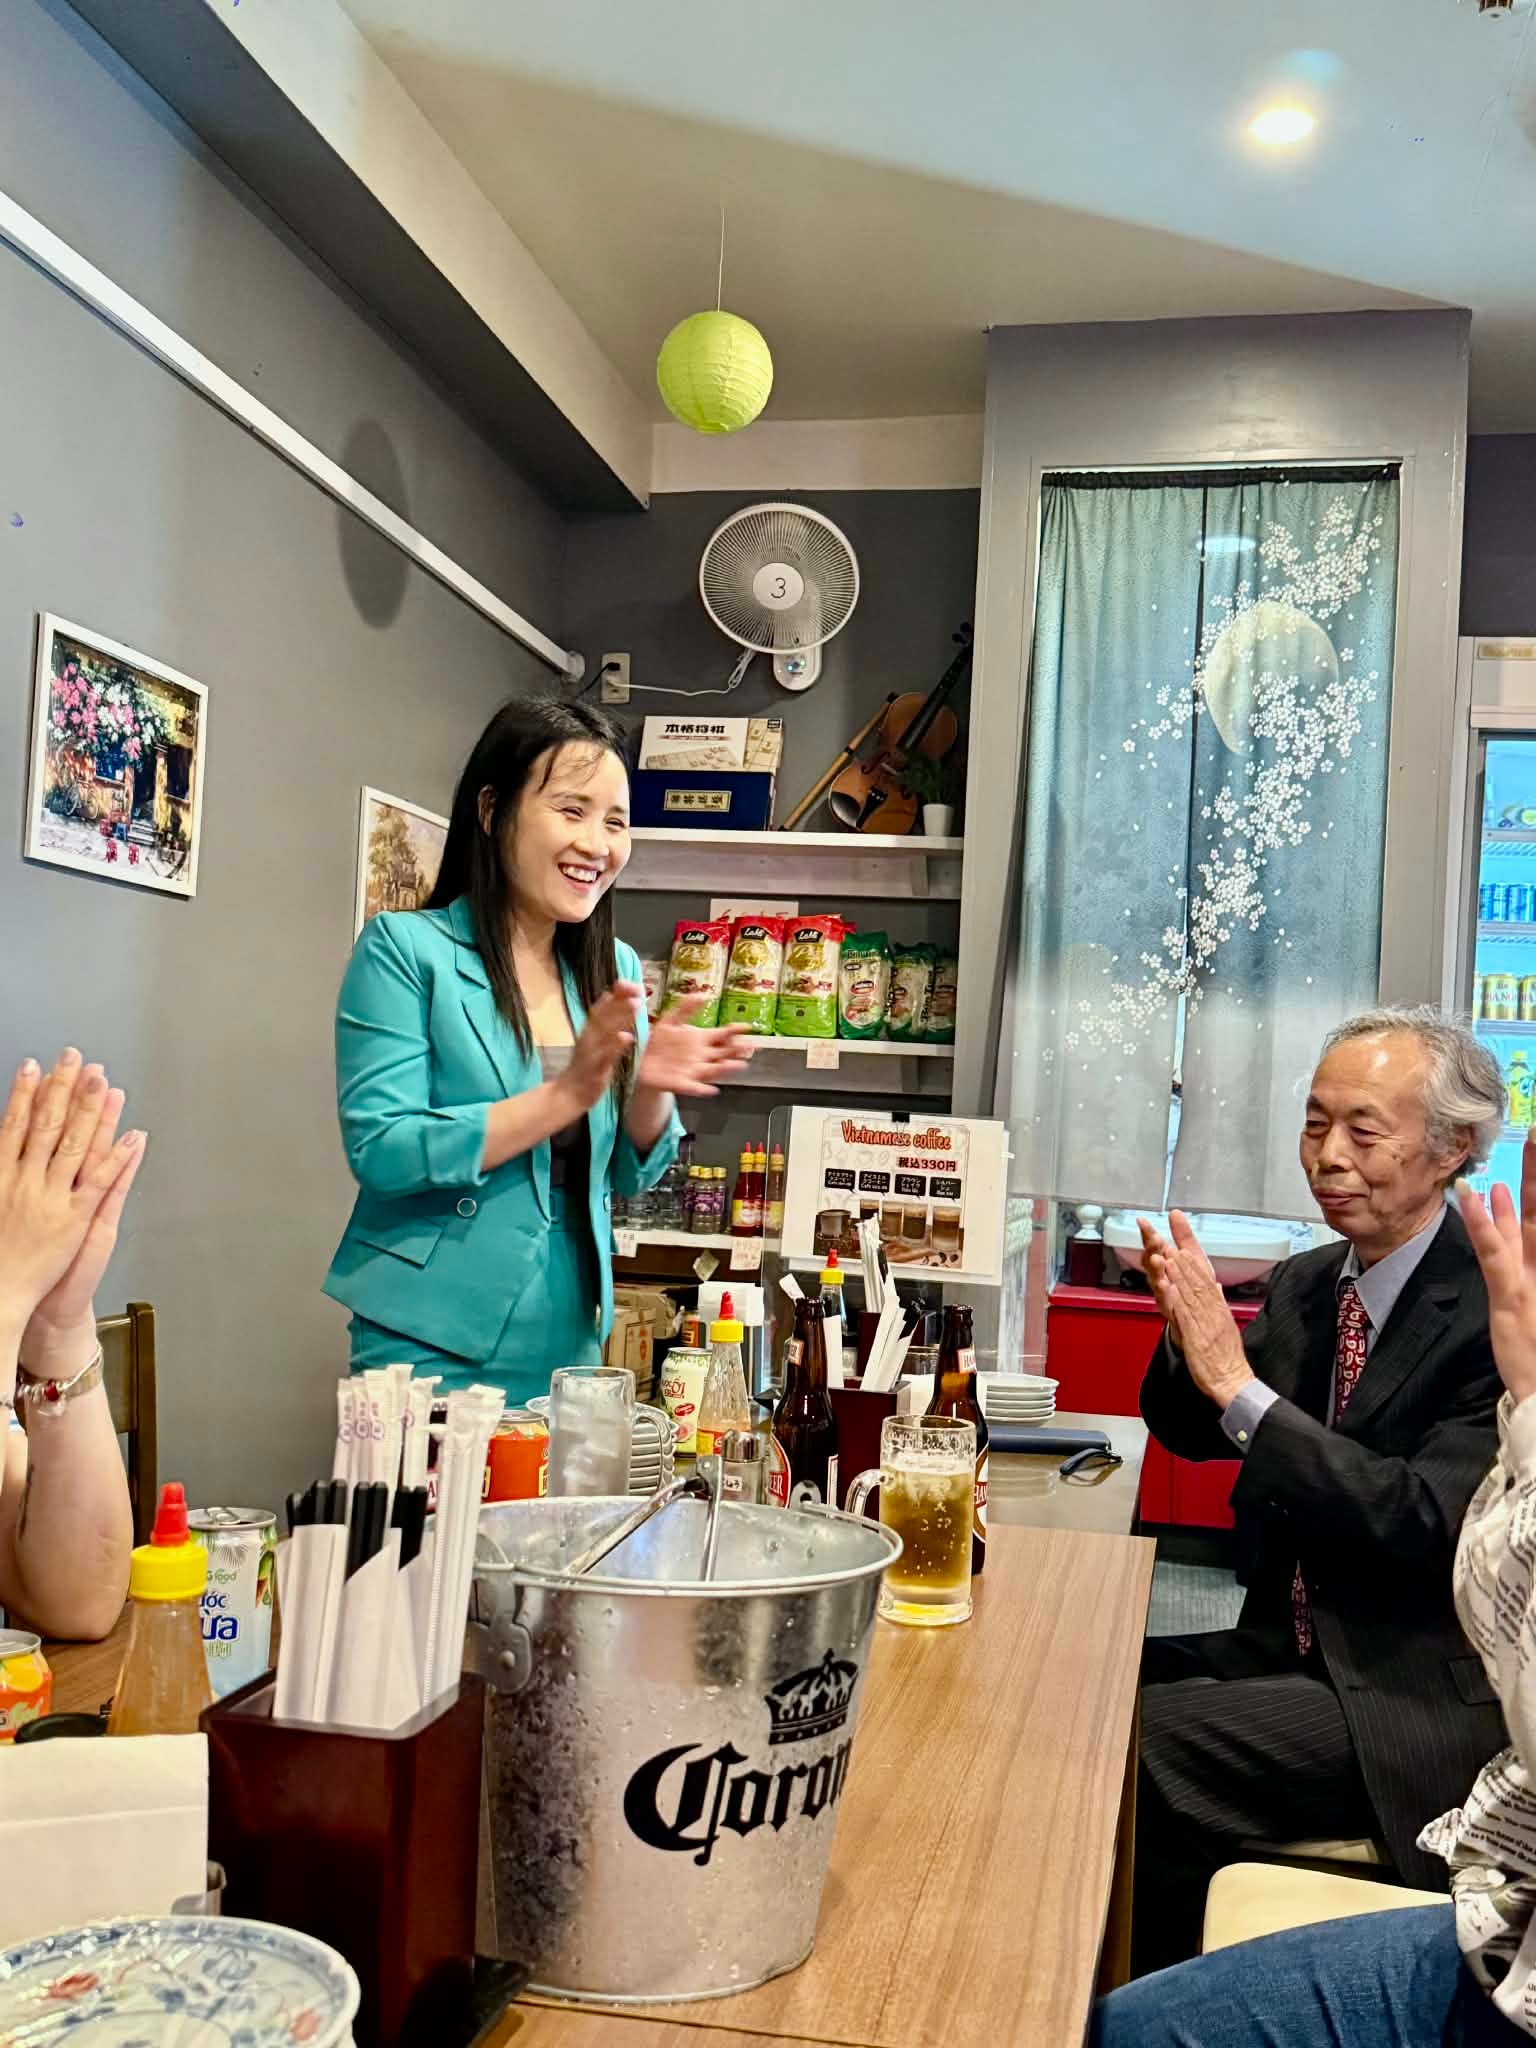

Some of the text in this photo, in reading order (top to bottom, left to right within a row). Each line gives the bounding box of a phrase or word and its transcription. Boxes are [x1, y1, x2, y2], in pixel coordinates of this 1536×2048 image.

[771, 577, 786, 599] 3
[840, 1119, 952, 1151] Vietnamese coffee
[898, 1157, 957, 1173] 税込330円
[200, 1609, 238, 1640] ừa
[623, 1738, 853, 1867] Coron
